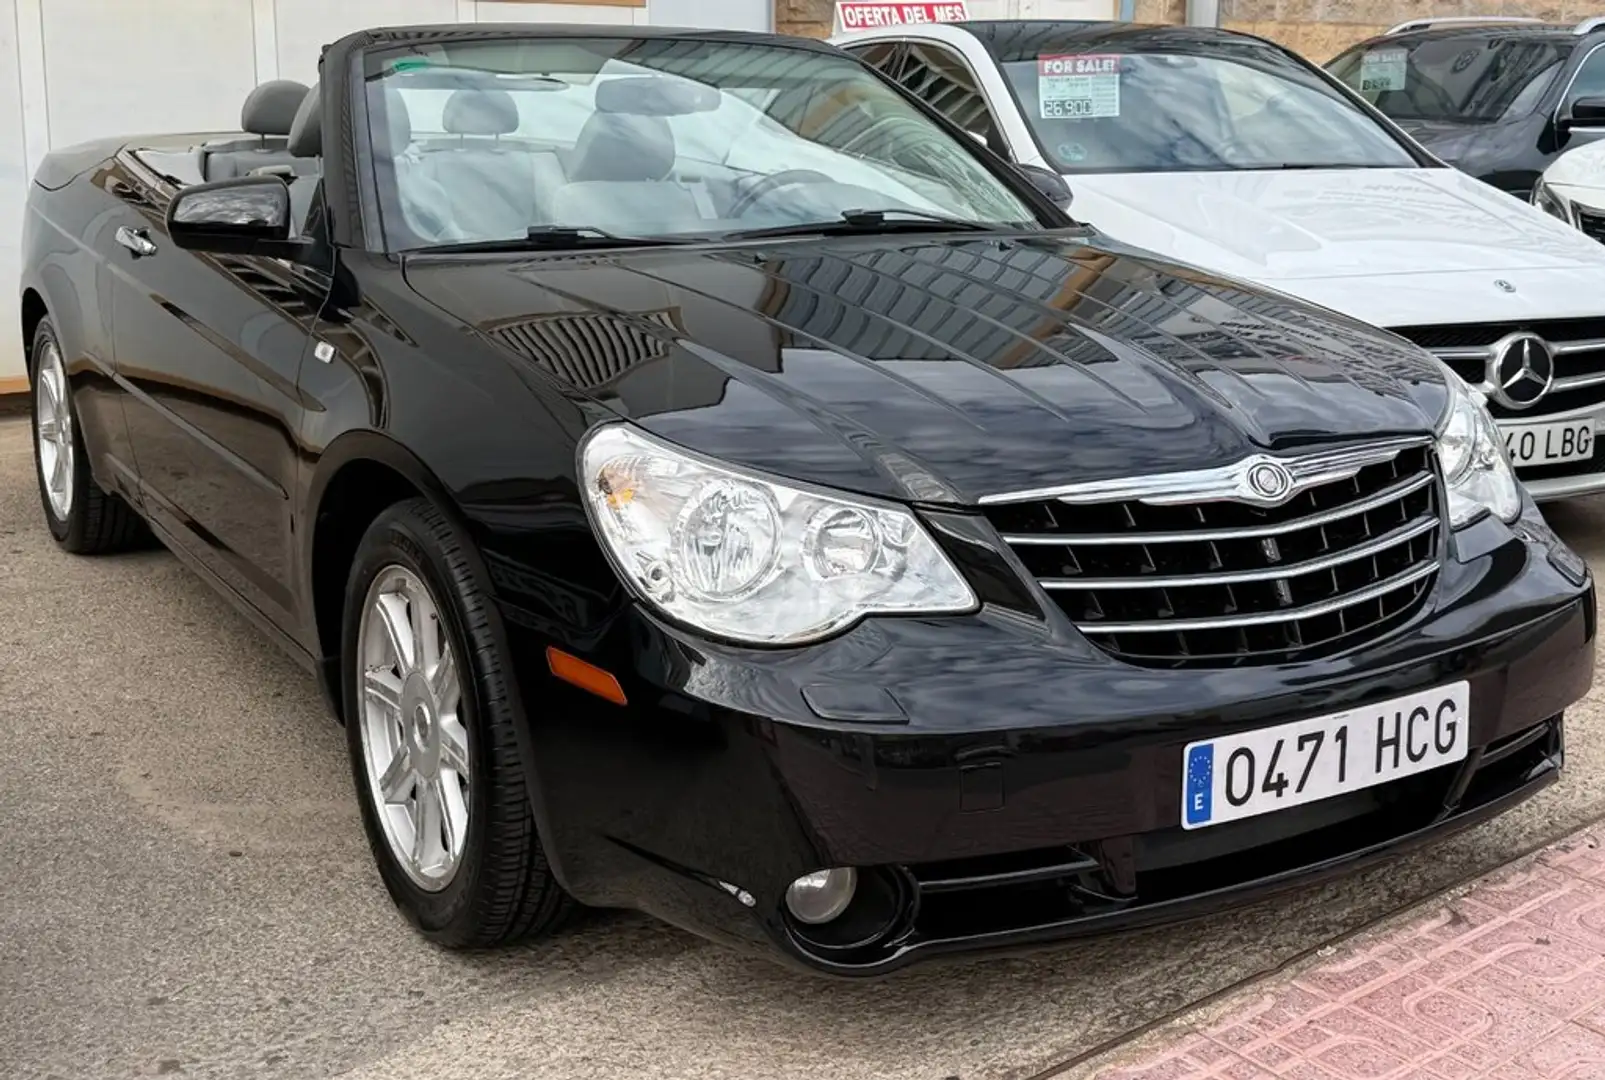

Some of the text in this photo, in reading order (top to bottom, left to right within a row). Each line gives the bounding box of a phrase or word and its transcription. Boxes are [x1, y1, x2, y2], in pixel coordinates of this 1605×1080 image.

[844, 5, 964, 26] OFERTA DEL MES
[1044, 60, 1073, 74] FOR
[1545, 425, 1592, 459] LBG
[1225, 698, 1457, 807] 0471 HCG
[1194, 792, 1204, 811] E
